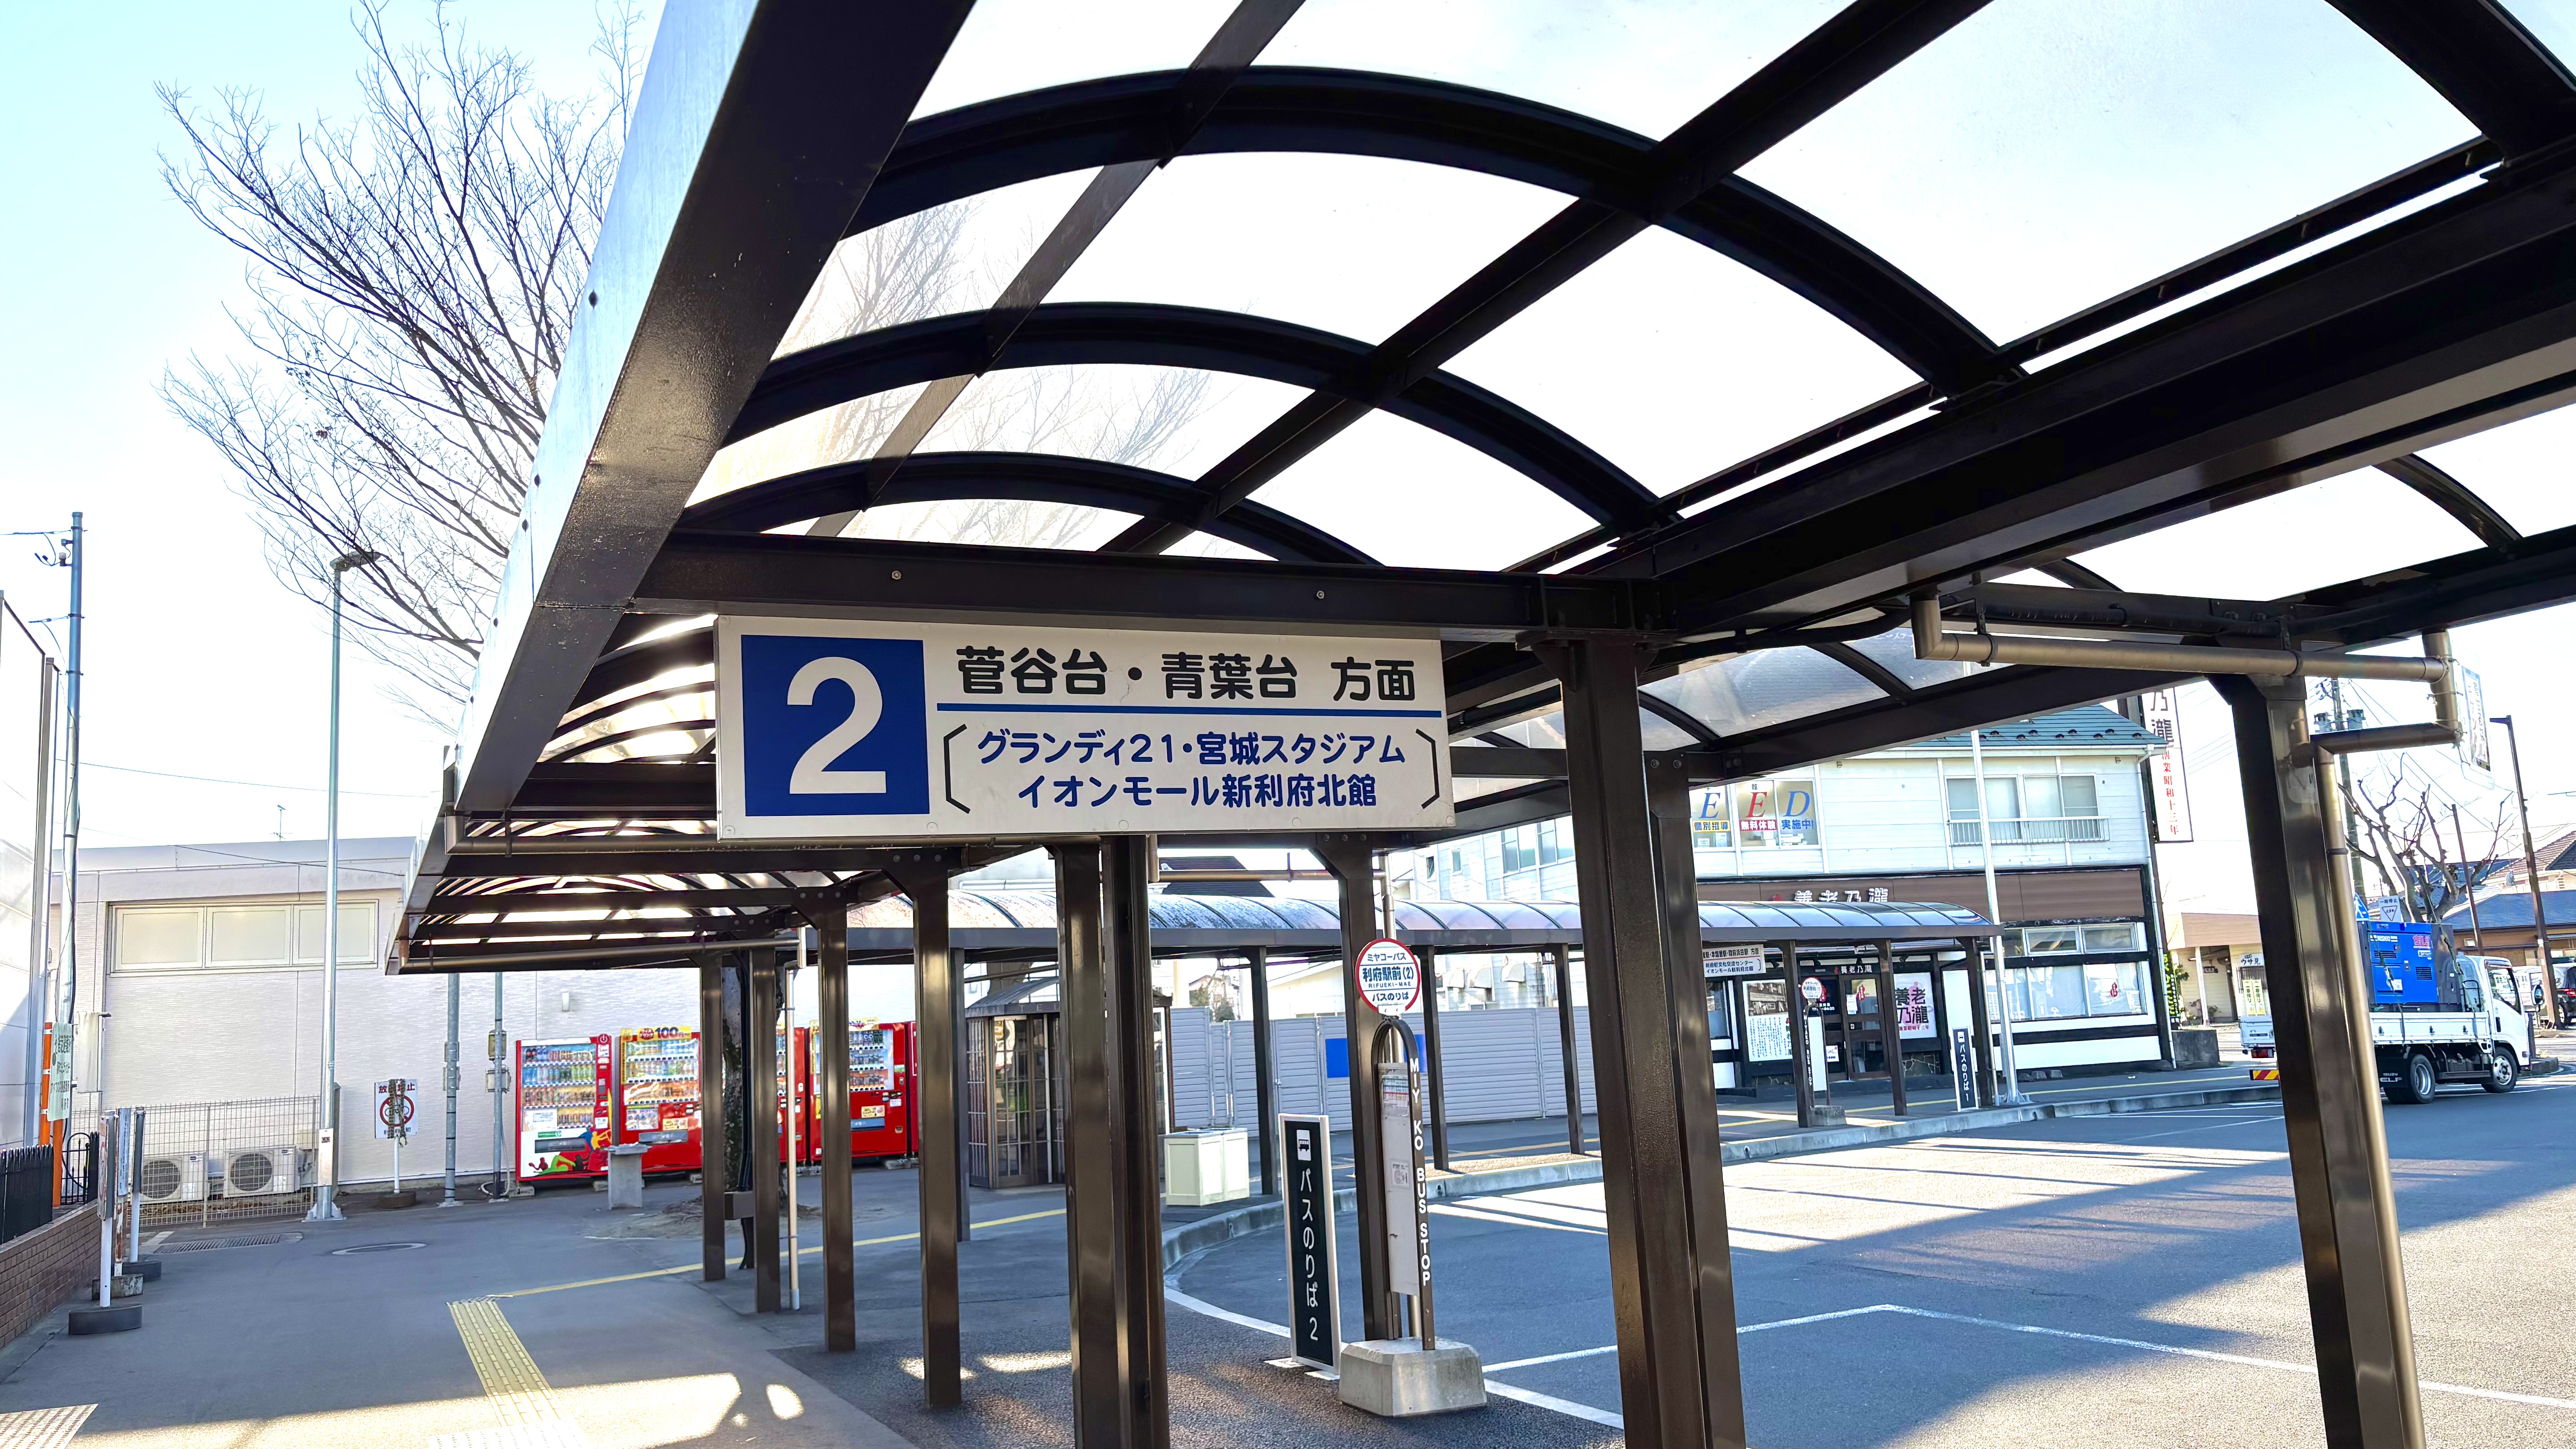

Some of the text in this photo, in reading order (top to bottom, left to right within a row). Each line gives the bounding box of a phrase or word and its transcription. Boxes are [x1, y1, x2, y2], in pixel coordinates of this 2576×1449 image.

[957, 646, 1415, 701] 菅谷台・青葉台 方面
[787, 657, 886, 794] 2
[978, 728, 1405, 765] グランディ21・宮城スタジアム
[1019, 773, 1376, 808] イオンモール新利府北館
[1741, 820, 1776, 830] 無料体験
[1362, 966, 1414, 982] 利府駅前(2)
[1367, 952, 1406, 961] ミヤコーバス
[1372, 992, 1409, 1002] バスのりば
[1897, 1006, 1929, 1024] 乃瀧
[655, 1027, 679, 1038] 100
[1960, 1044, 1969, 1091] バスのりば
[1417, 1168, 1426, 1213] BUS
[1301, 1168, 1318, 1340] バスのりば 2
[1421, 1223, 1430, 1286] STOP
